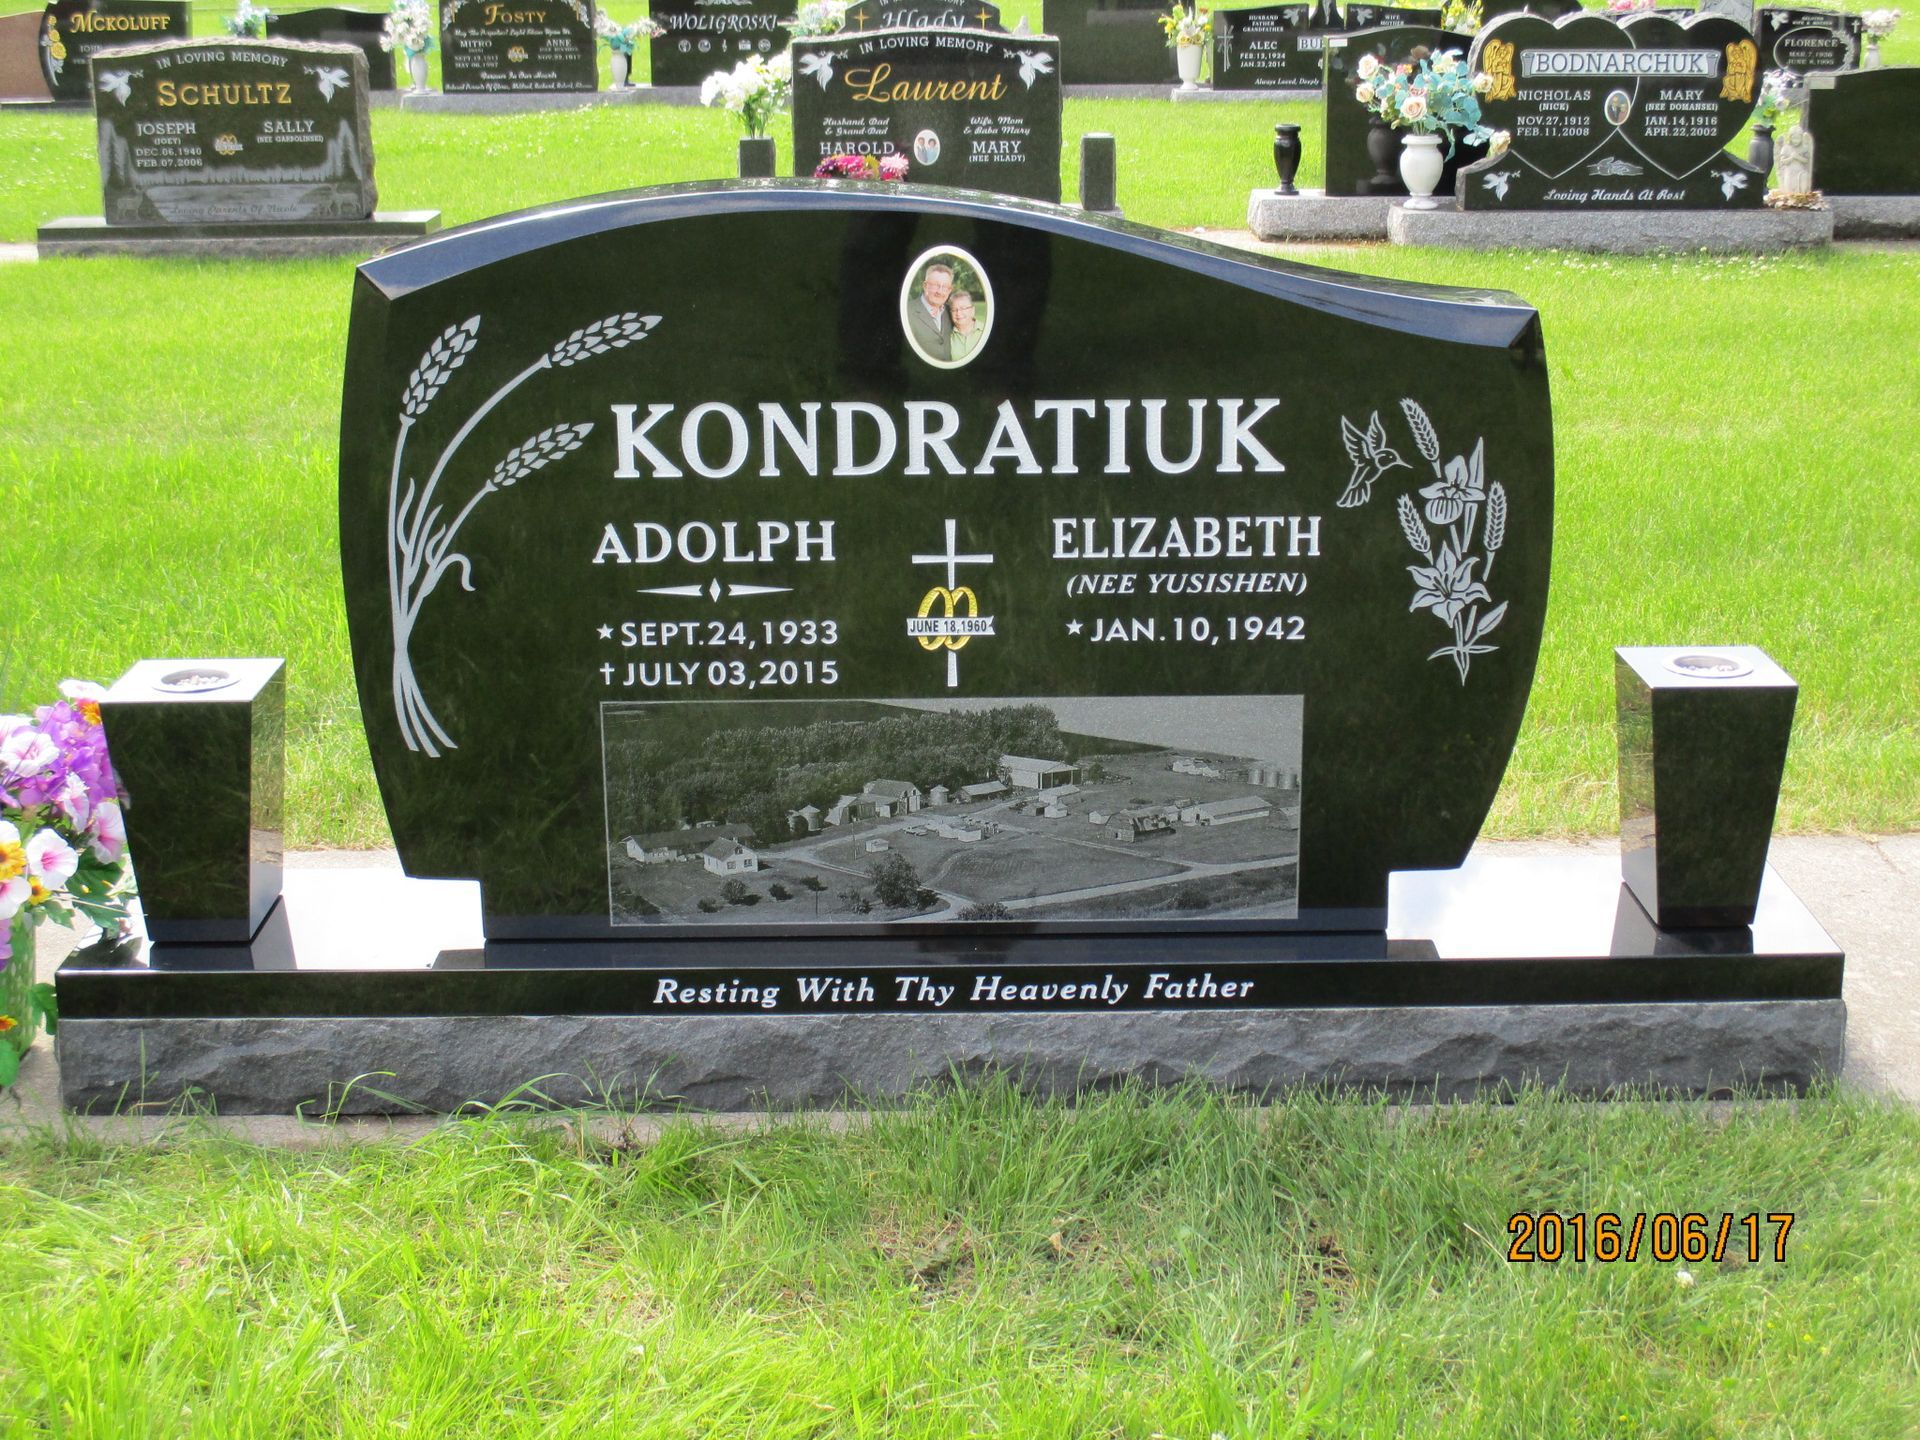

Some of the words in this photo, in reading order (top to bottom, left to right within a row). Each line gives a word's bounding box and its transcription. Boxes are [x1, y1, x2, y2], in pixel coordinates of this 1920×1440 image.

[485, 4, 546, 25] FOSTY
[879, 9, 966, 29] Hlady
[669, 13, 779, 34] WOLIGROSKI
[460, 40, 492, 48] MITRO
[546, 39, 572, 47] ANNE
[860, 43, 874, 55] IN
[879, 36, 930, 50] LOVING
[935, 36, 994, 54] MEMORY
[1249, 41, 1278, 50] ALEC
[1784, 39, 1838, 48] FLORENCE
[156, 58, 172, 70] IN
[176, 51, 226, 65] LOVING
[231, 51, 289, 67] MEMORY
[1535, 53, 1704, 73] BODNARCHUK
[844, 62, 1009, 102] Laurent
[158, 80, 292, 107] SCHULTZ
[1517, 90, 1591, 101] NICHOLAS
[1660, 90, 1704, 101] MARY
[1538, 102, 1570, 112] (NICK)
[1645, 103, 1666, 112] (NEE
[1669, 102, 1719, 112] DOMANSKI)
[263, 120, 315, 134] SALLY
[868, 117, 890, 126] Dad
[997, 116, 1024, 125] Mom
[1516, 116, 1590, 126] NOV.27,1912
[1645, 116, 1718, 127] JAN.14,1916
[136, 122, 197, 137] JOSEPH
[825, 128, 834, 136] &
[963, 127, 972, 135] &
[974, 127, 999, 135] Baba
[1001, 127, 1031, 136] Mary
[1516, 128, 1590, 138] FEB.11,2008
[1644, 128, 1718, 138] APR.22,2002
[154, 137, 182, 145] (JOEY)
[971, 140, 1022, 154] MARY
[136, 147, 202, 157] DEC.06,1940
[819, 141, 895, 156] HAROLD
[969, 154, 989, 163] (NEE
[993, 154, 1026, 163] HLADY)
[1543, 189, 1590, 203] Loving
[1592, 189, 1634, 201] Hands
[1636, 189, 1654, 201] At
[1655, 189, 1686, 201] Rest
[610, 398, 1286, 480] KONDRATIUK
[591, 520, 837, 565] ADOLPH
[1052, 515, 1322, 560] ELIZABETH
[1066, 572, 1136, 598] (NEE
[1148, 571, 1309, 597] YUSISHEN)
[910, 619, 939, 633] JUNE
[944, 619, 987, 634] 18,1960
[621, 620, 839, 652] SEPT.24,1933
[623, 660, 701, 688] JULY
[707, 659, 840, 690] 03,2015
[653, 977, 781, 1009] Resting
[796, 976, 876, 1003] With
[896, 976, 956, 1007] Thy
[970, 974, 1128, 1005] Heavenly
[1143, 973, 1255, 999] Father
